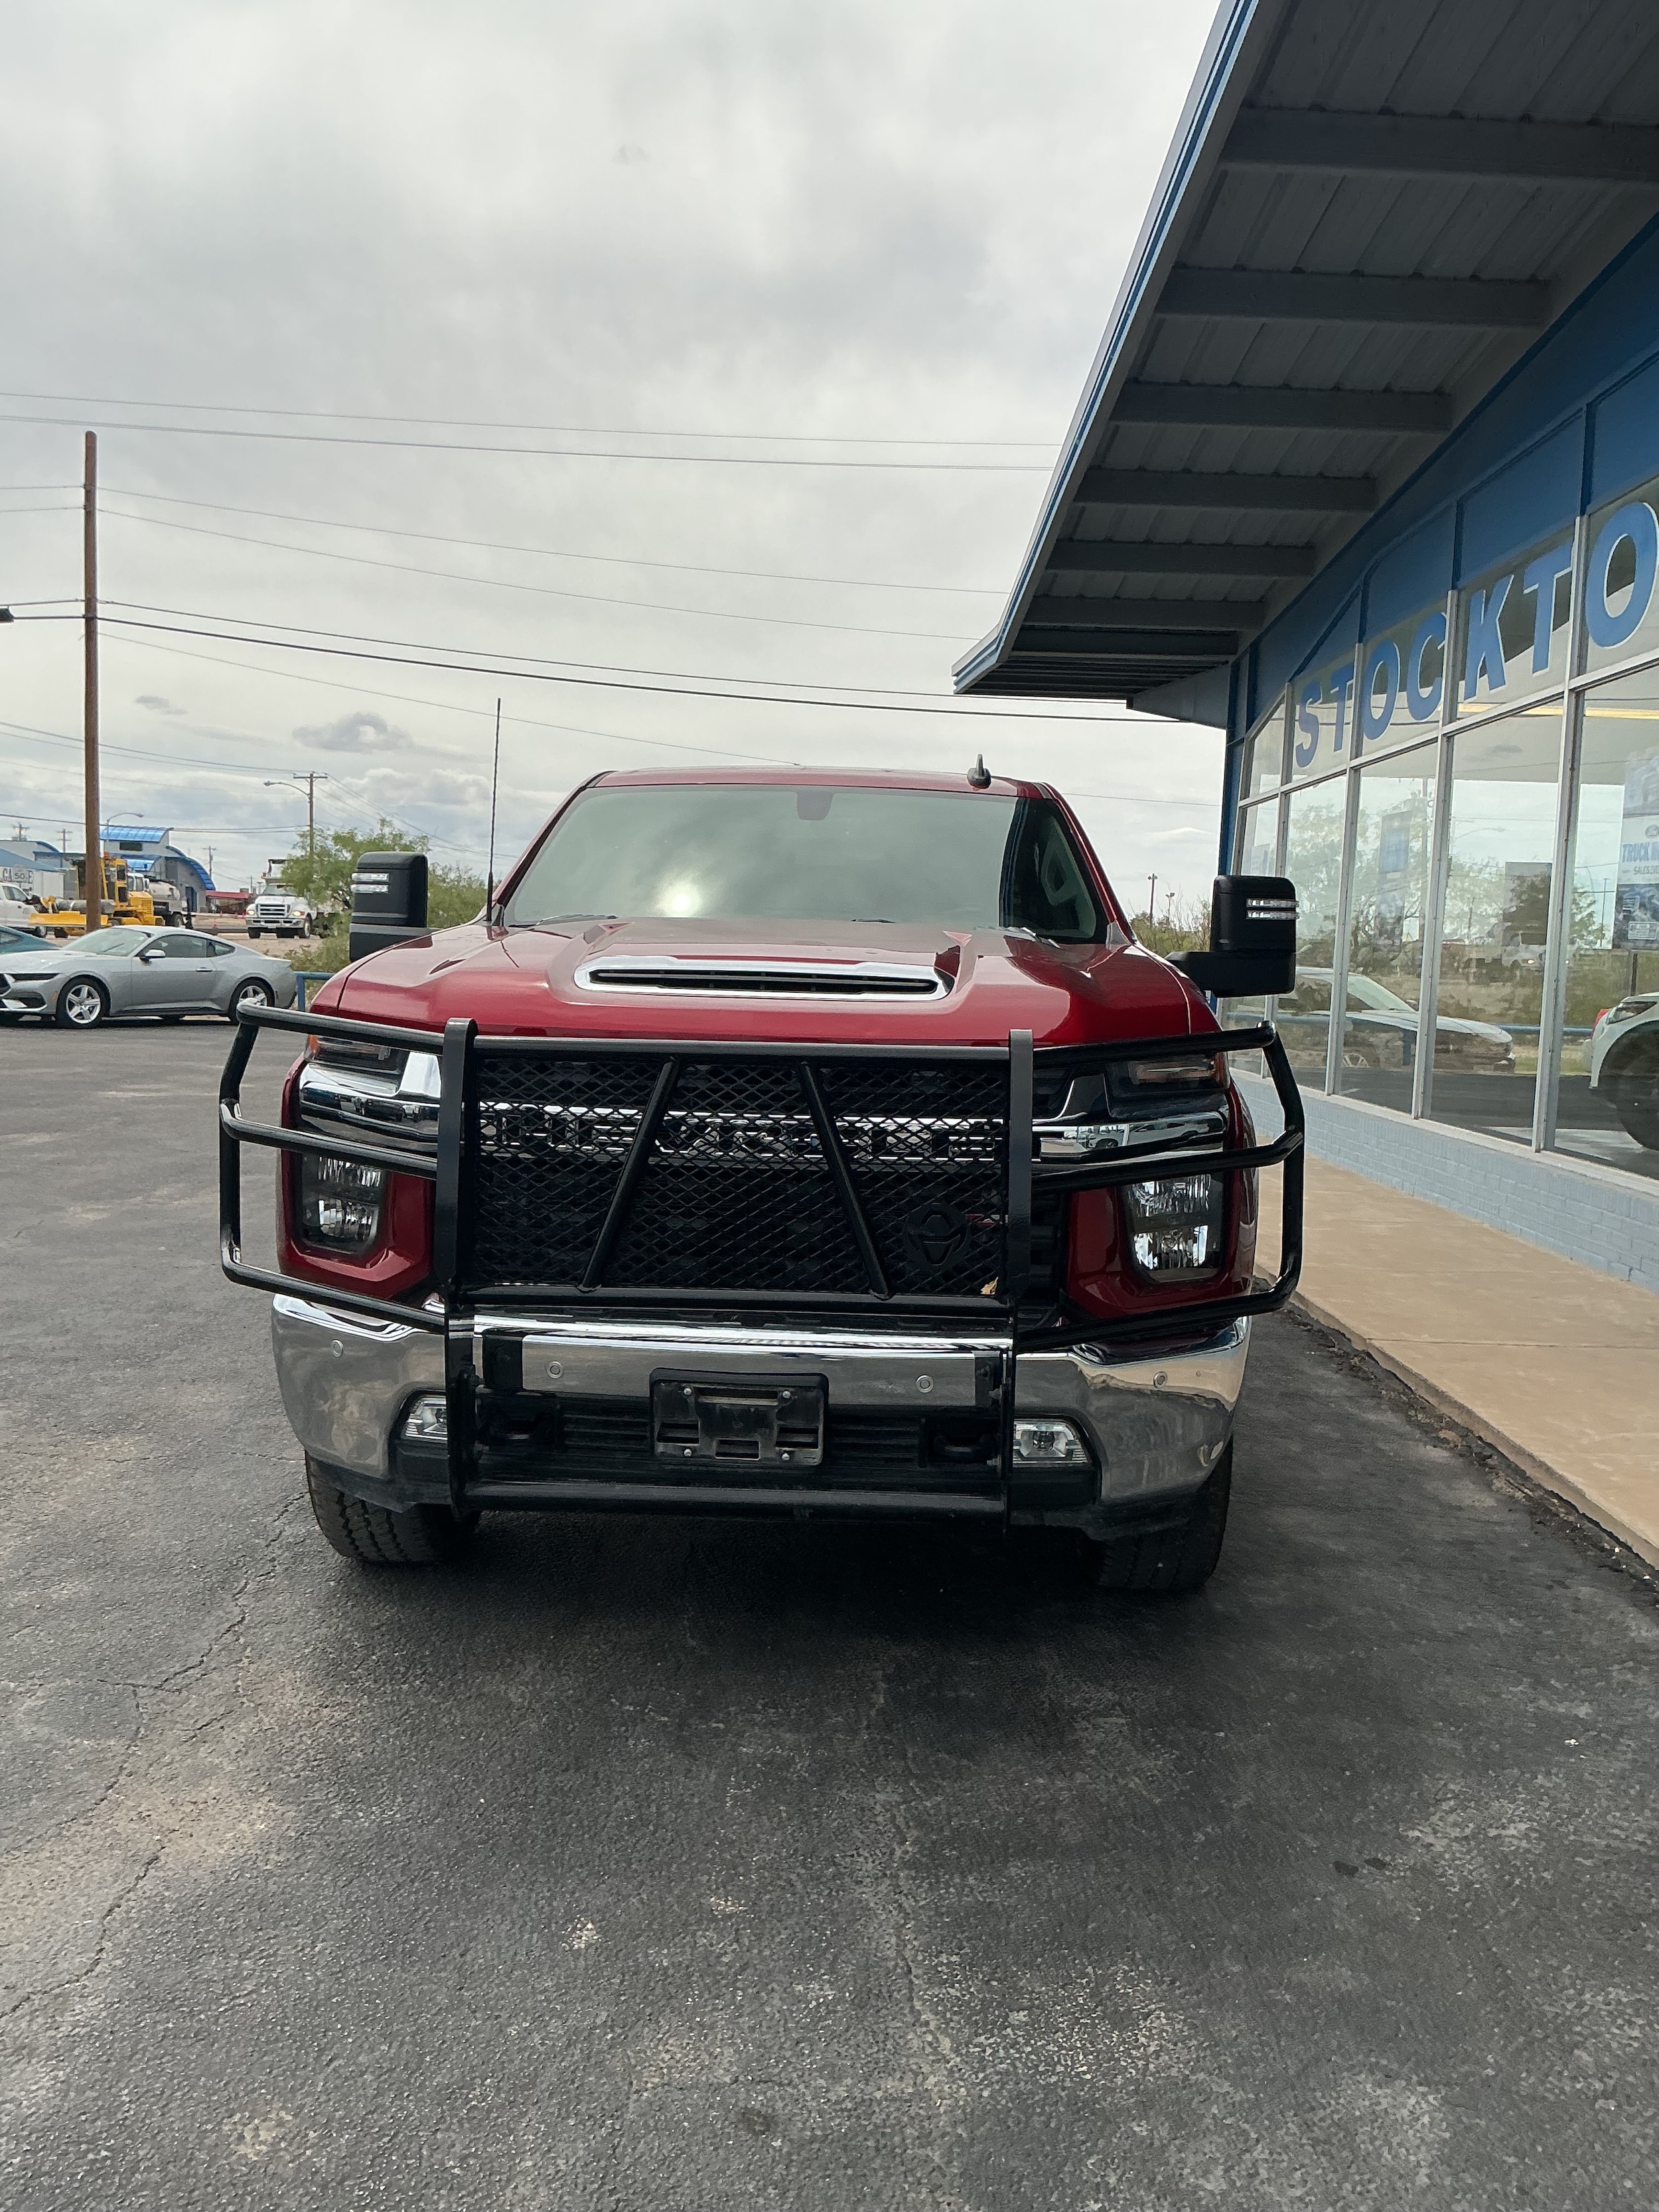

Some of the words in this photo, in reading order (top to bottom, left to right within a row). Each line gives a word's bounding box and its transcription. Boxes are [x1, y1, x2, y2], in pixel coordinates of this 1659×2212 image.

[1295, 502, 1659, 768] STOCKTO
[1622, 842, 1650, 863] TRUCK
[1634, 865, 1650, 875] SALES
